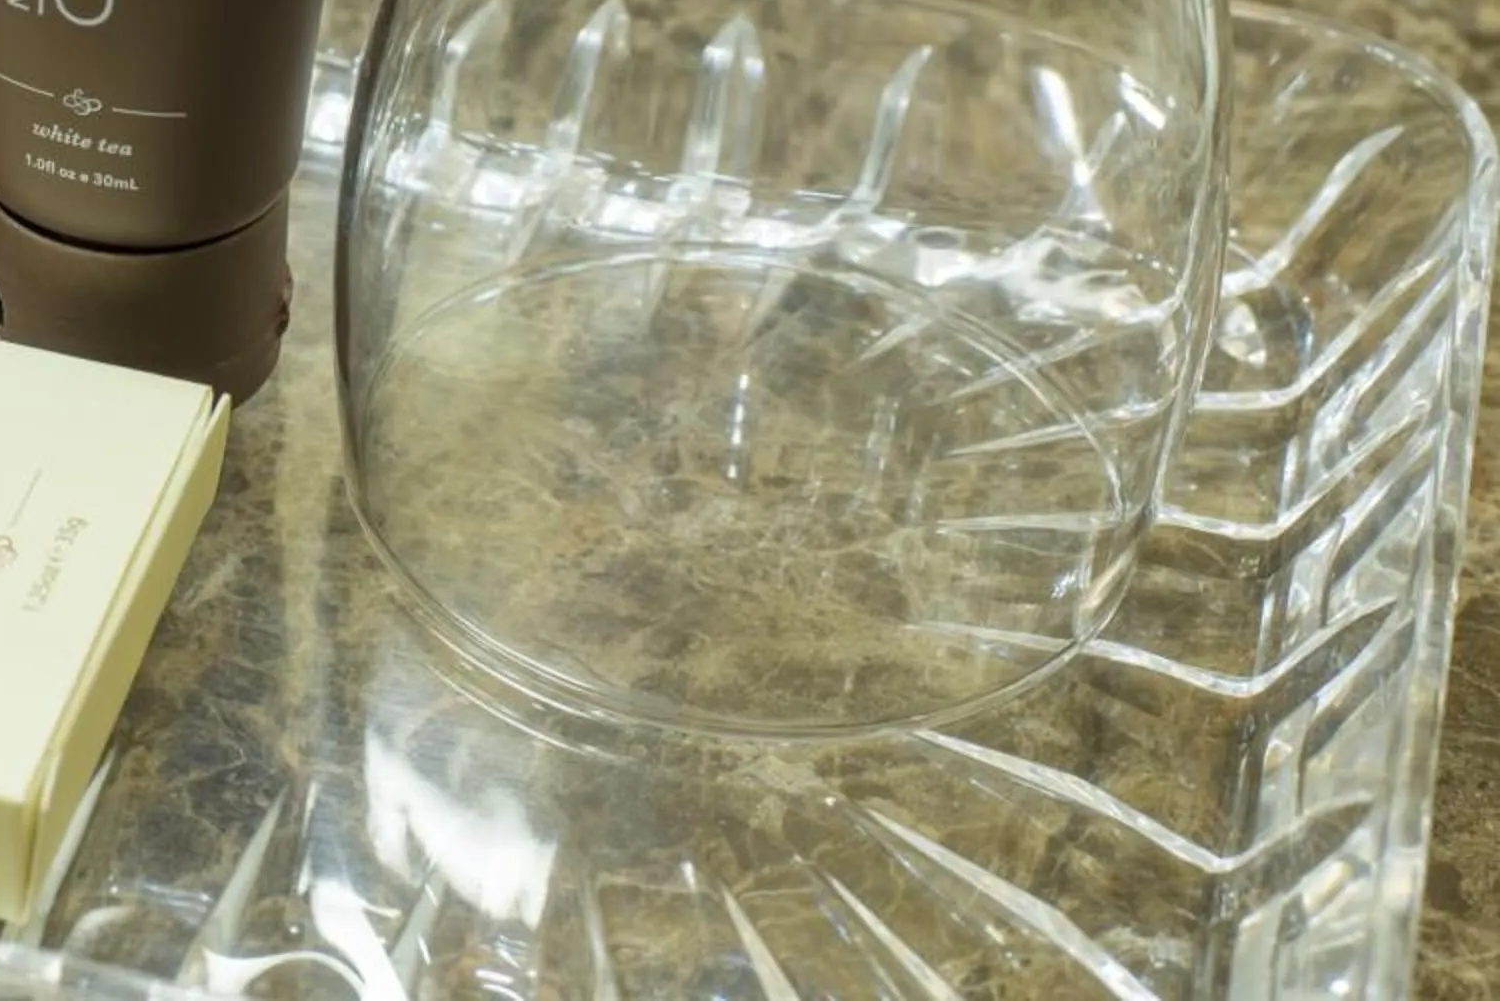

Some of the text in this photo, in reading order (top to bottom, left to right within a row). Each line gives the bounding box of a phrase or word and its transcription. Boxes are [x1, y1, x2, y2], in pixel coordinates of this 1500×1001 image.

[32, 122, 132, 156] white tea
[25, 152, 56, 175] 1.0fl
[58, 167, 77, 180] oz
[92, 171, 140, 191] 30mL
